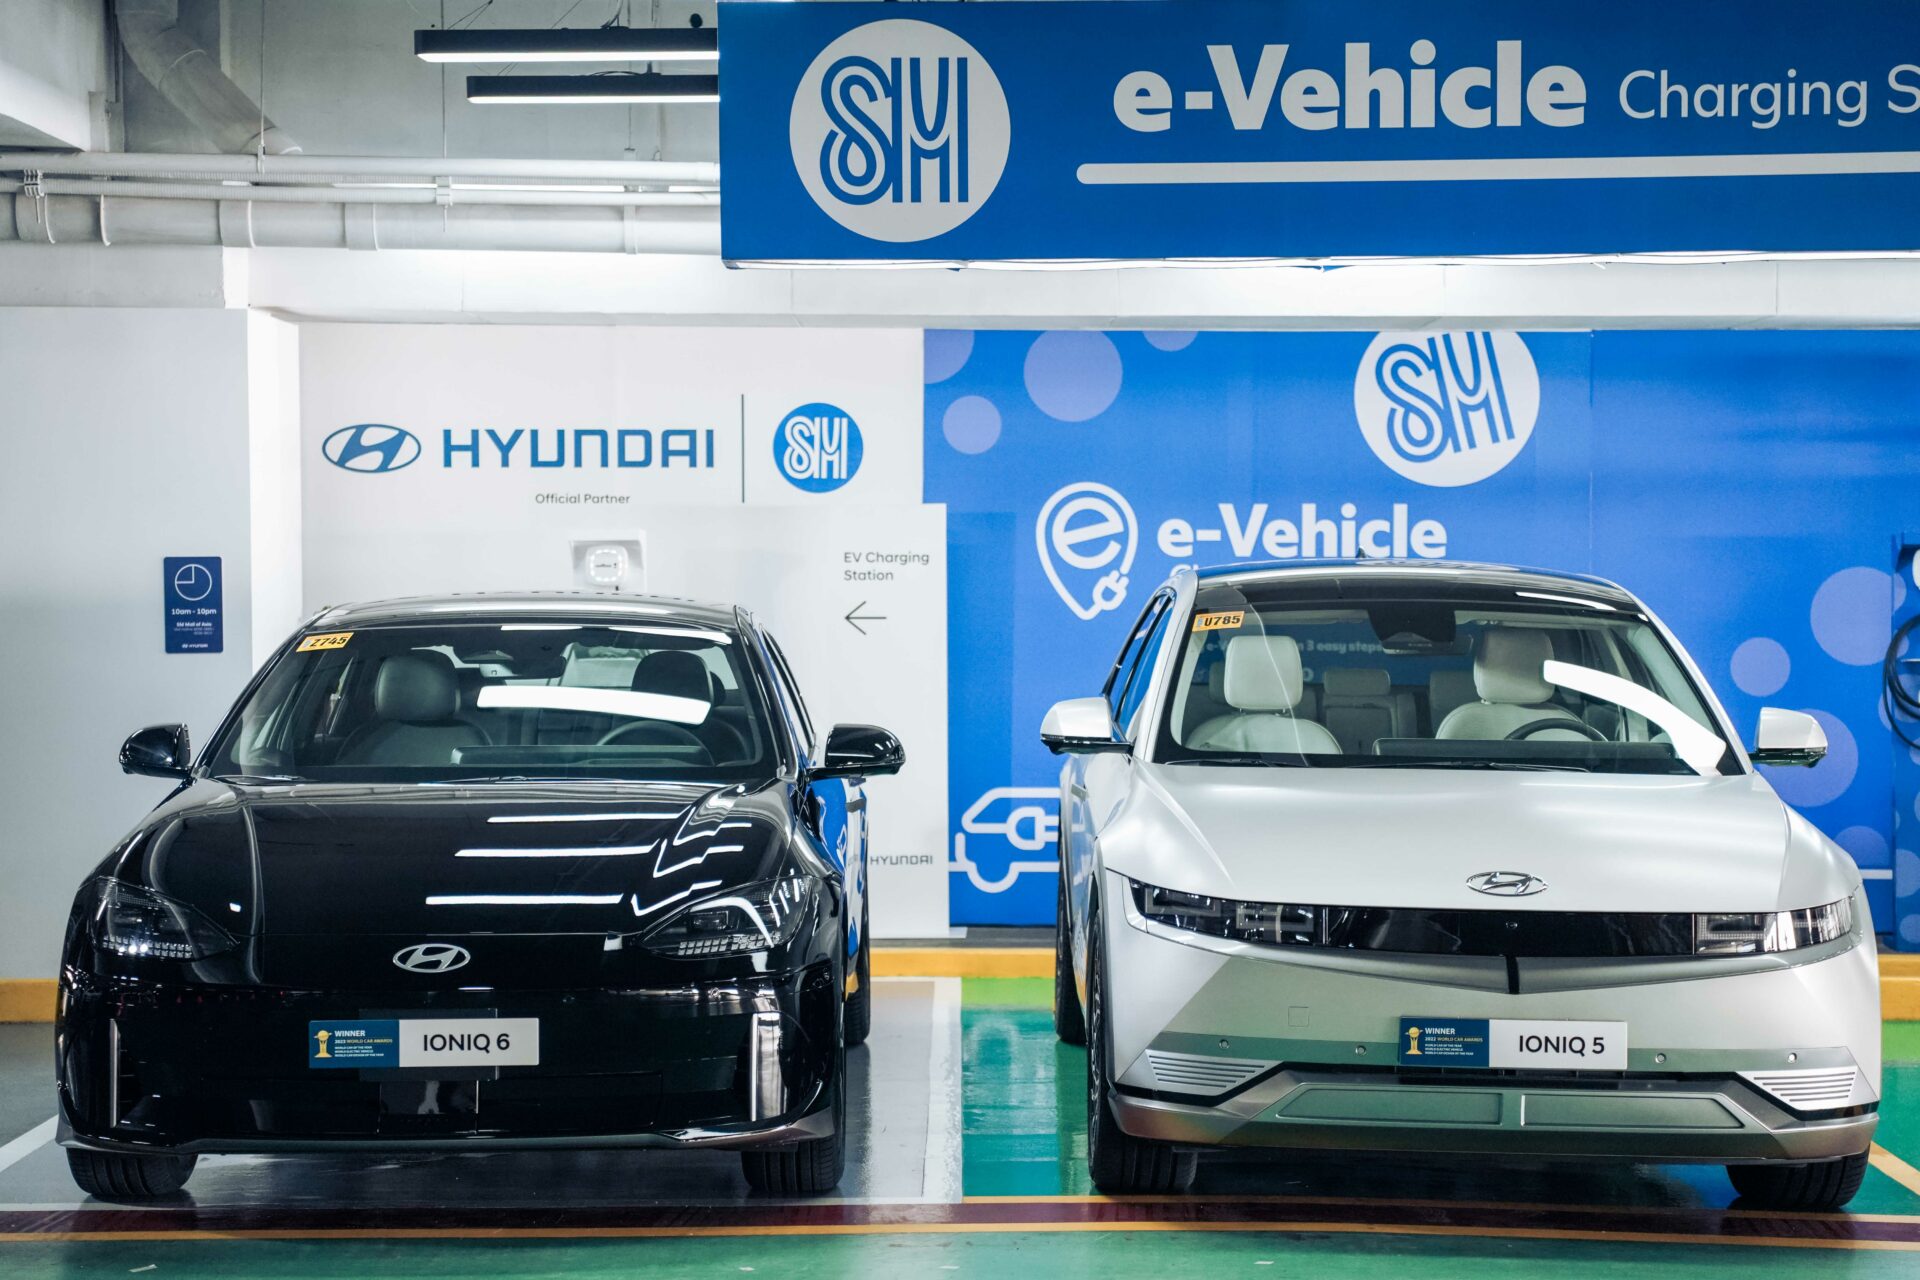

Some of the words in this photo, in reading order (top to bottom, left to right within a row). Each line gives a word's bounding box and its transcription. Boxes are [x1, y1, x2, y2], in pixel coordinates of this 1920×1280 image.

[1113, 38, 1587, 133] e-Vehicle
[1619, 68, 1868, 130] Charging
[818, 55, 970, 206] SM
[442, 428, 716, 468] HYUNDAI
[783, 414, 848, 480] SM
[535, 492, 581, 504] Official
[583, 492, 631, 504] Partner
[1157, 501, 1448, 560] e-Vehicle
[843, 551, 862, 564] EV
[865, 551, 930, 567] Charging
[843, 569, 894, 582] Station
[171, 608, 192, 616] 10am
[197, 608, 217, 616] 10pm
[1204, 615, 1241, 627] U785
[309, 637, 349, 647] Z745
[1316, 642, 1347, 654] easy
[869, 854, 934, 866] HYUNDAI
[1424, 1027, 1456, 1035] WINNER
[423, 1033, 491, 1054] IONIQ
[496, 1033, 510, 1051] 6
[1519, 1035, 1586, 1057] IONIQ
[1591, 1036, 1605, 1055] 5
